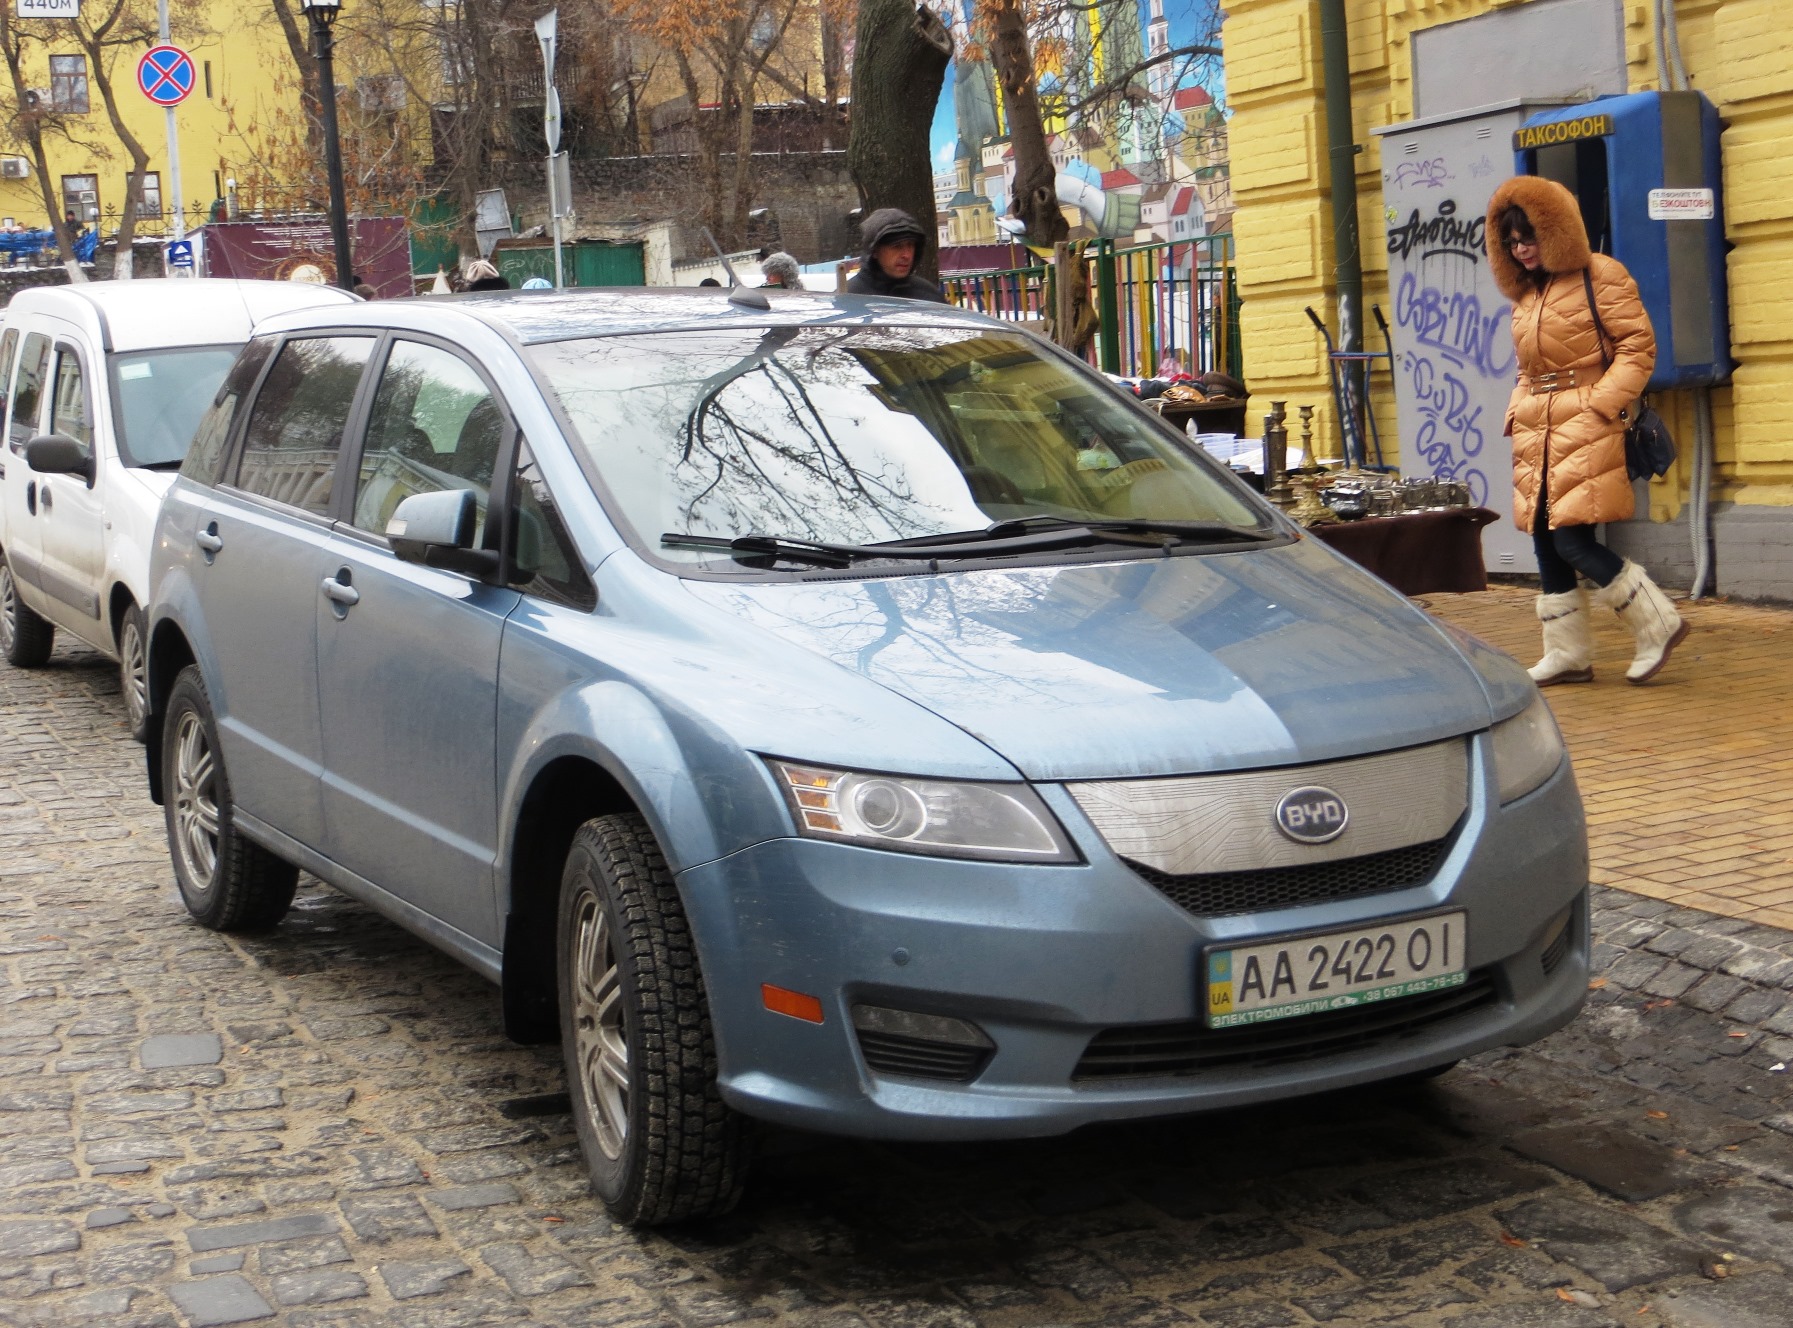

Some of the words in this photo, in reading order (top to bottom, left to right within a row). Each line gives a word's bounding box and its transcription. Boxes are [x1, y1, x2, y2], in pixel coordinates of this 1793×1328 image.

[1516, 115, 1605, 148] ТАКСОФОН
[1286, 800, 1341, 827] BYD
[1238, 950, 1297, 1003] AA
[1307, 933, 1396, 992] 2422
[1211, 992, 1230, 1006] UA
[1212, 1000, 1329, 1027] ЭЛЕКТРОМОБИЛИ
[1383, 985, 1404, 997] 067
